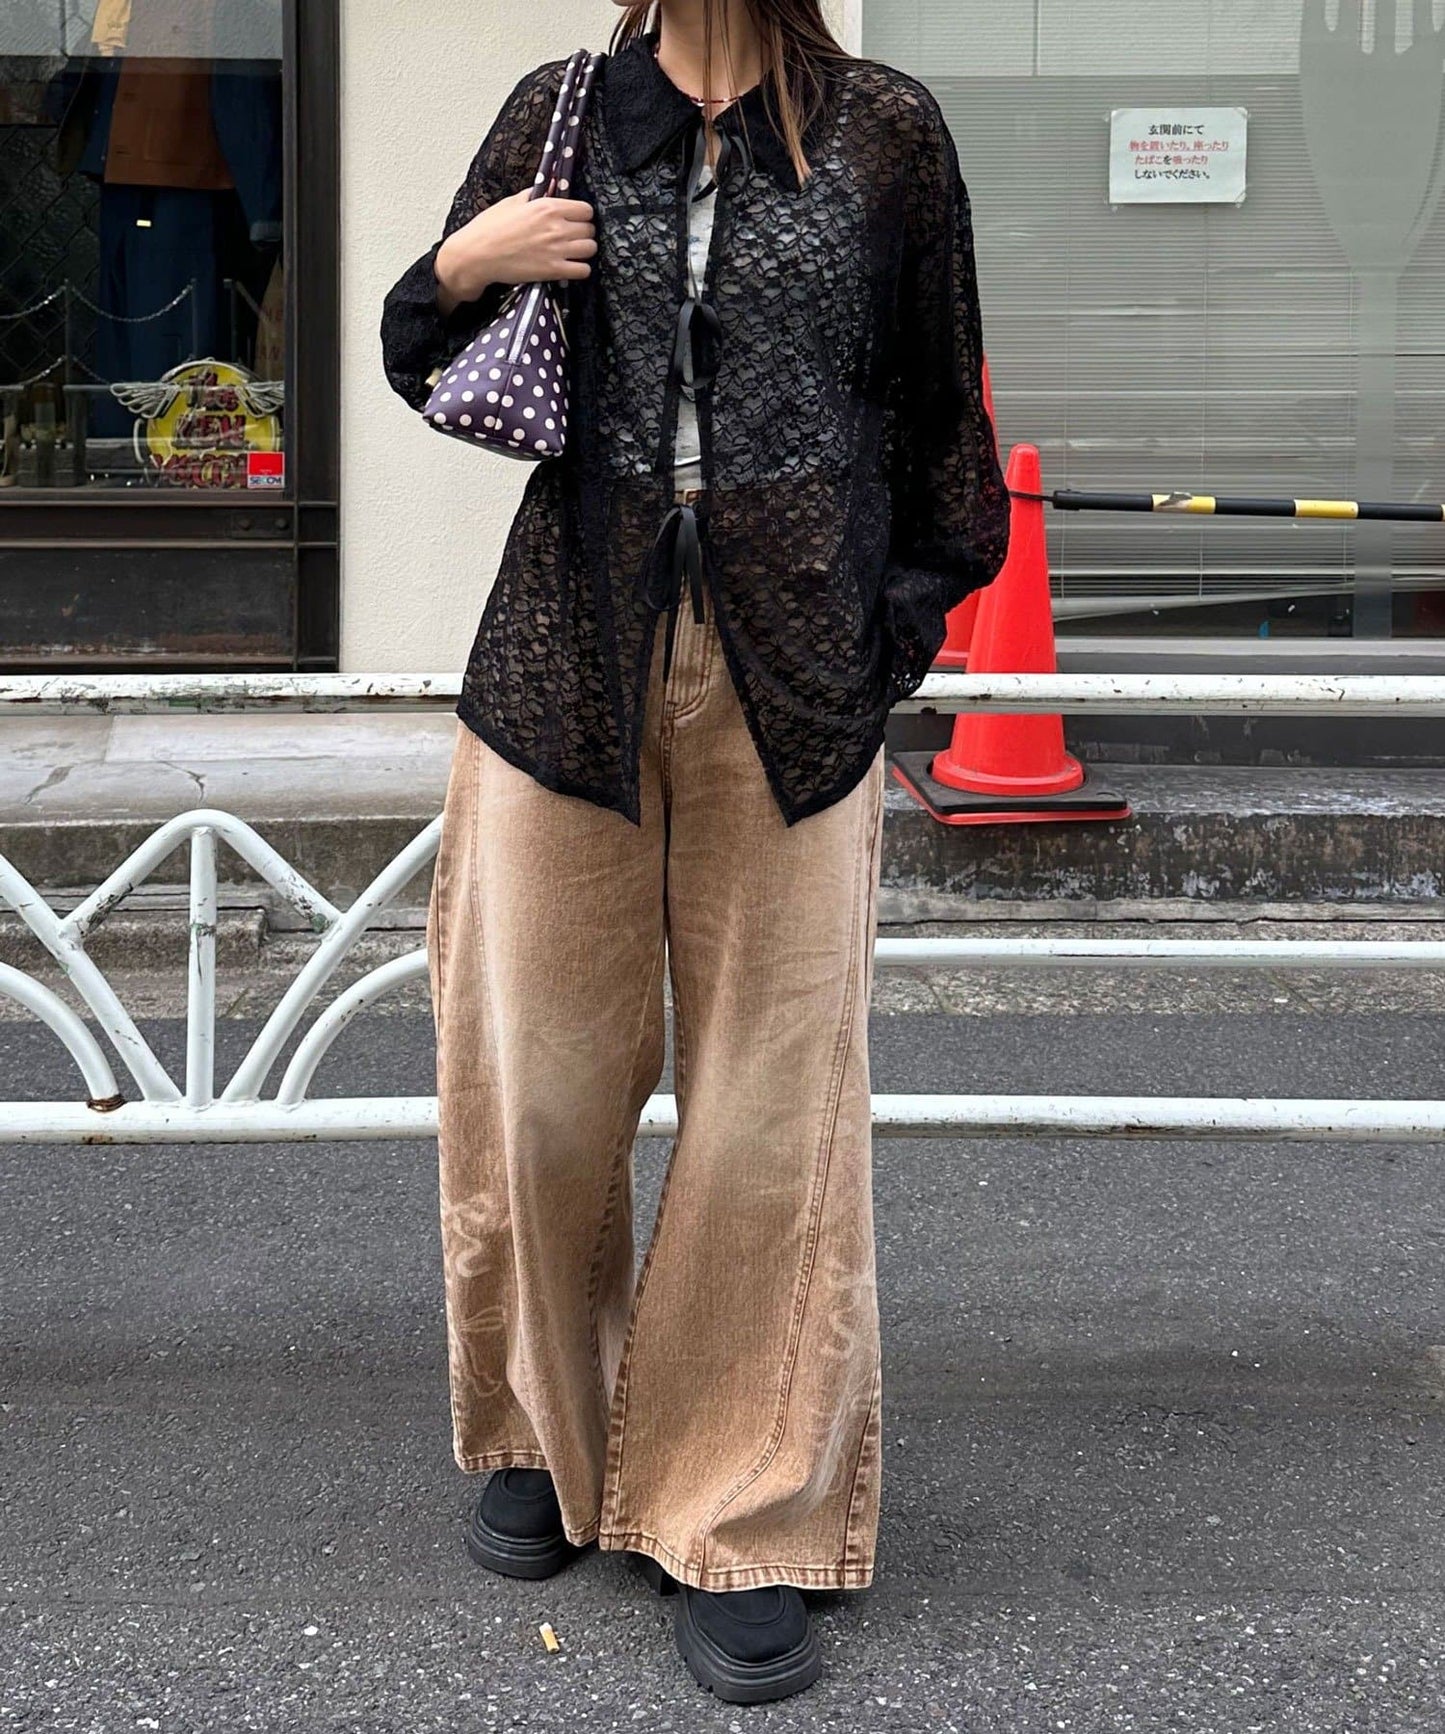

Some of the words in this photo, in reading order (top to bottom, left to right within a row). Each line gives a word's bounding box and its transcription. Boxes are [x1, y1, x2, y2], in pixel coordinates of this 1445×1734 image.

[1148, 124, 1205, 135] 玄関前にて
[1135, 155, 1208, 165] たばこを吸ったり
[1134, 169, 1210, 179] しないでください。
